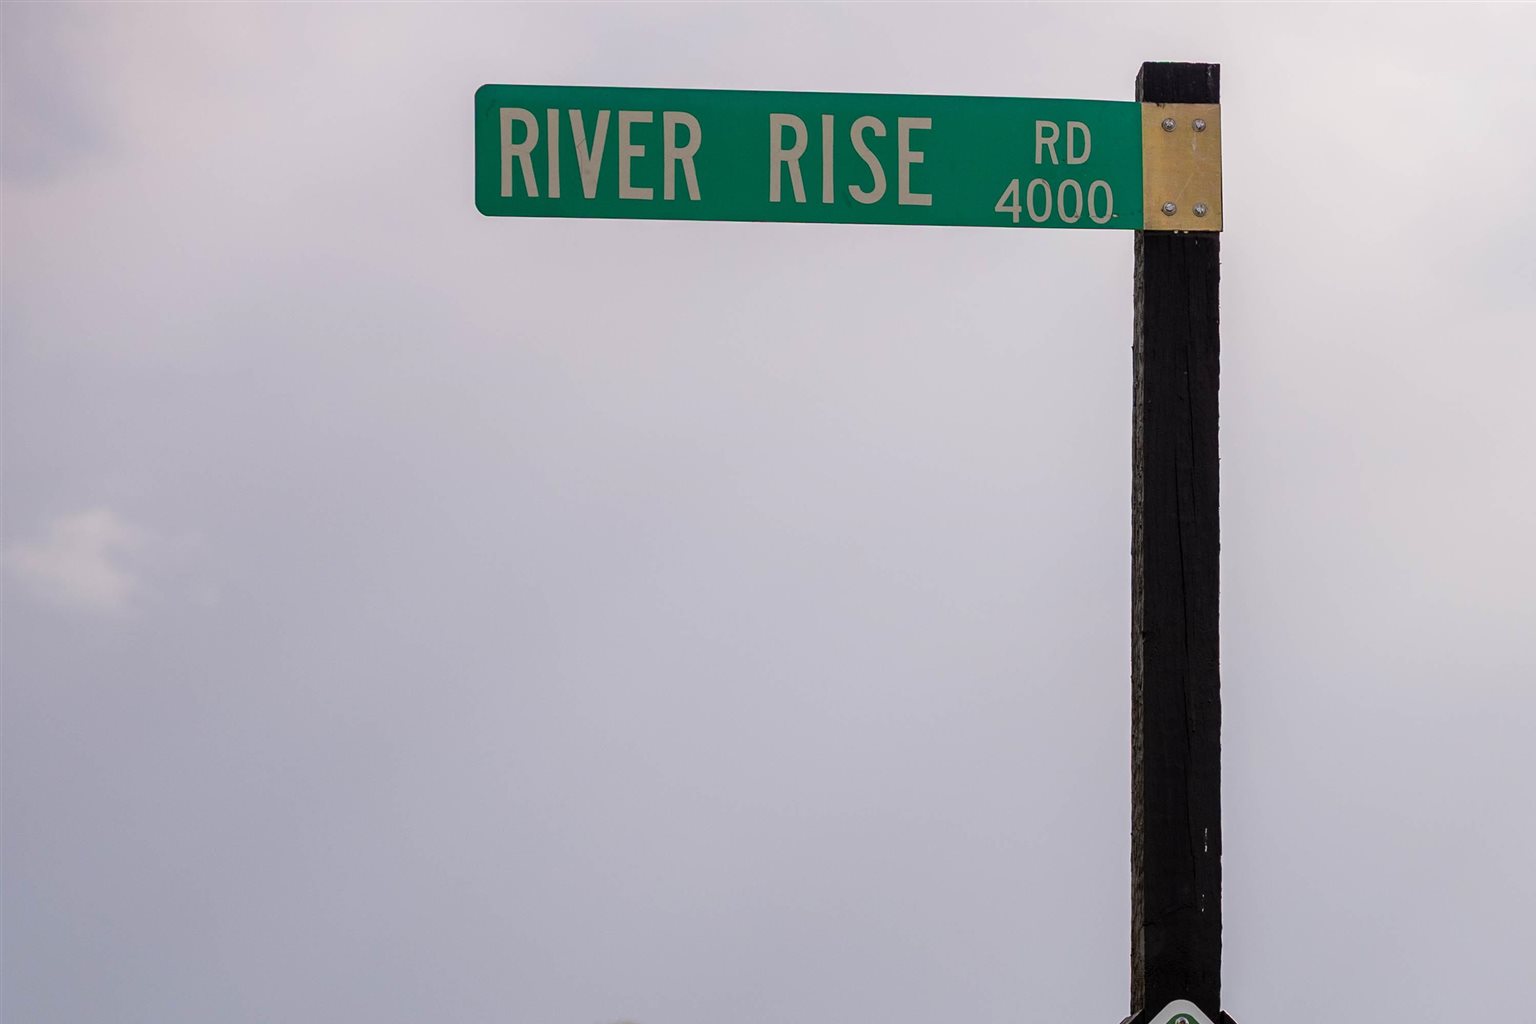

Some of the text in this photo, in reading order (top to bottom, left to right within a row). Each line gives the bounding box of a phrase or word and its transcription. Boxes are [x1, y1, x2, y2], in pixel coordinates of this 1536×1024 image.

[499, 107, 933, 206] RIVER RISE
[1035, 120, 1092, 165] RD
[994, 178, 1114, 224] 4000
